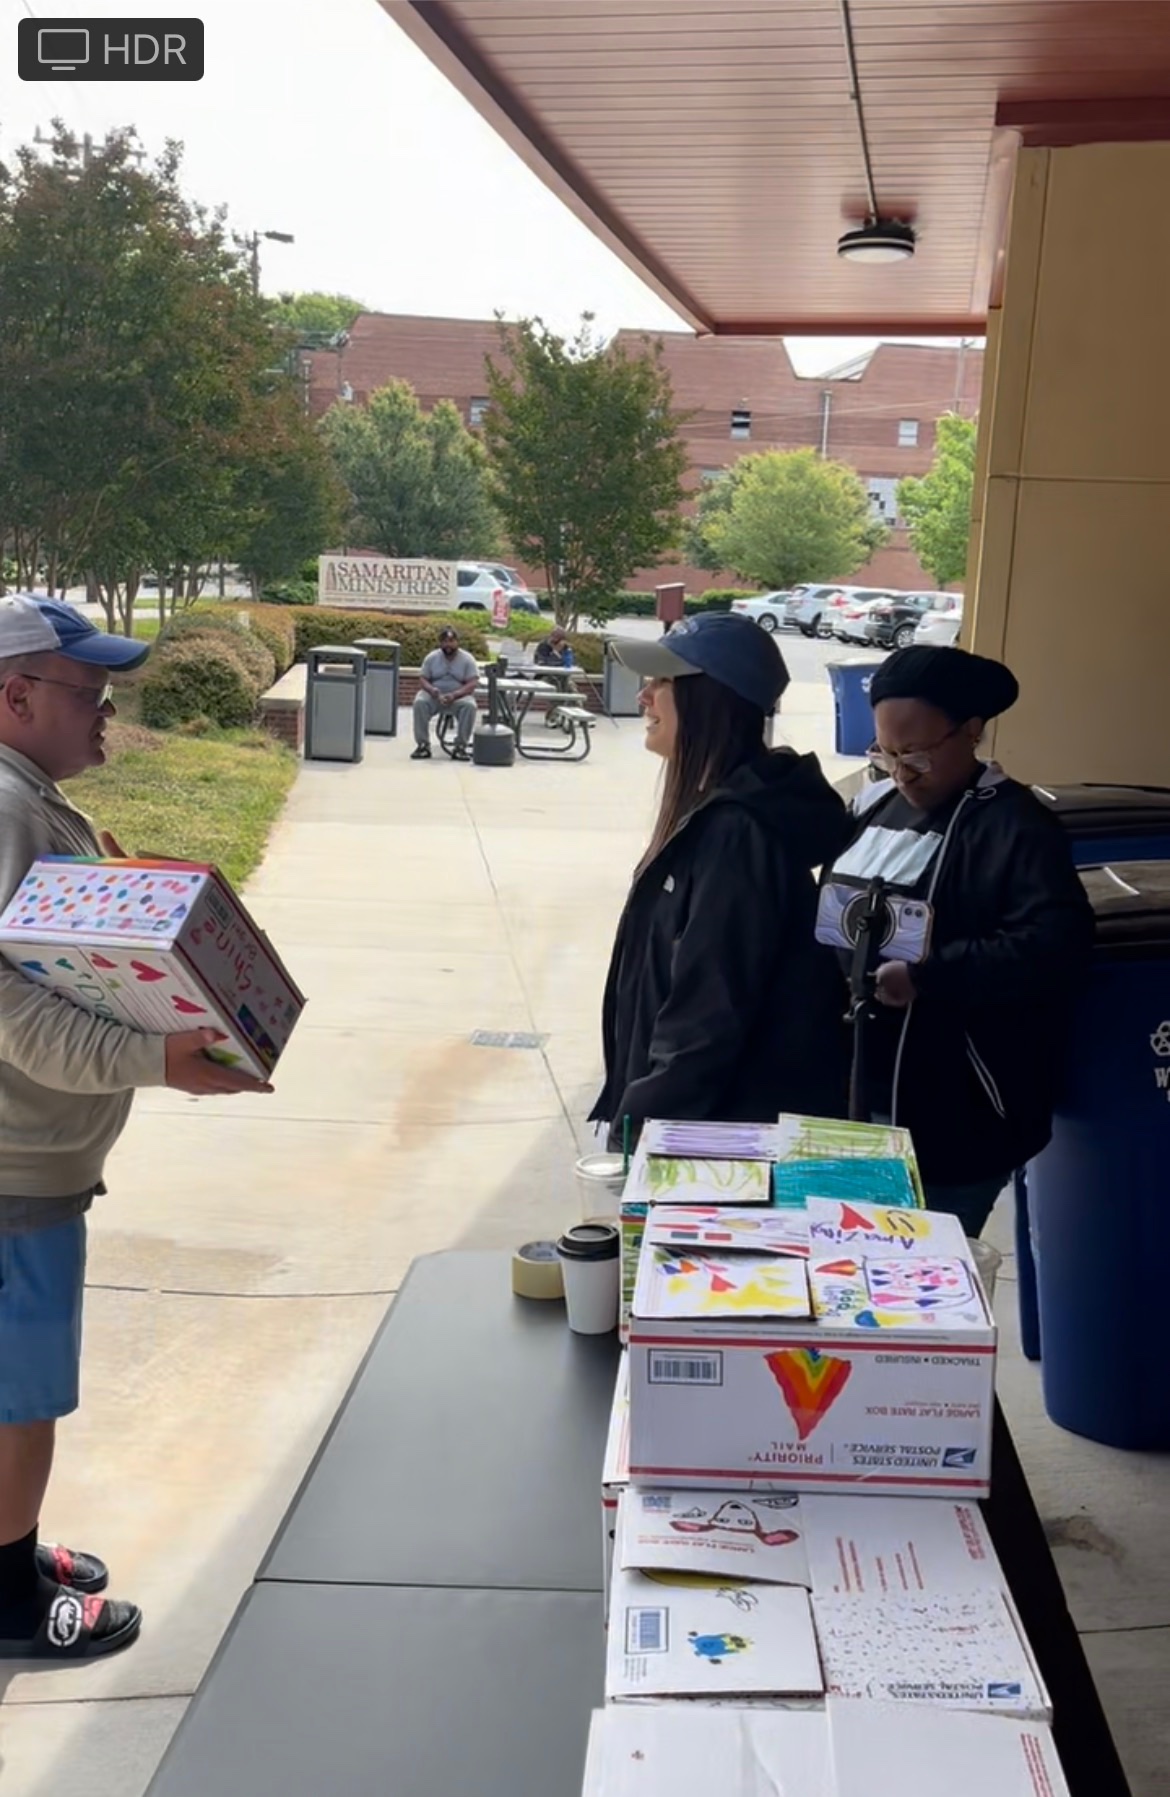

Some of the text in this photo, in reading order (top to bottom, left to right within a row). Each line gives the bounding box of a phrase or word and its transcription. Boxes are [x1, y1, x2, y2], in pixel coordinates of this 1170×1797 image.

[337, 561, 450, 580] SAMARITAN
[337, 577, 450, 596] MINISTRIES
[874, 1354, 981, 1366] TRACKED INSURED
[865, 1405, 981, 1418] LARGE FLAT RATE BOX
[770, 1440, 807, 1451] MAIL
[850, 1442, 942, 1456] POSTAL SERVICE
[754, 1451, 824, 1465] PRIORITY
[852, 1454, 938, 1468] UNITED STATES
